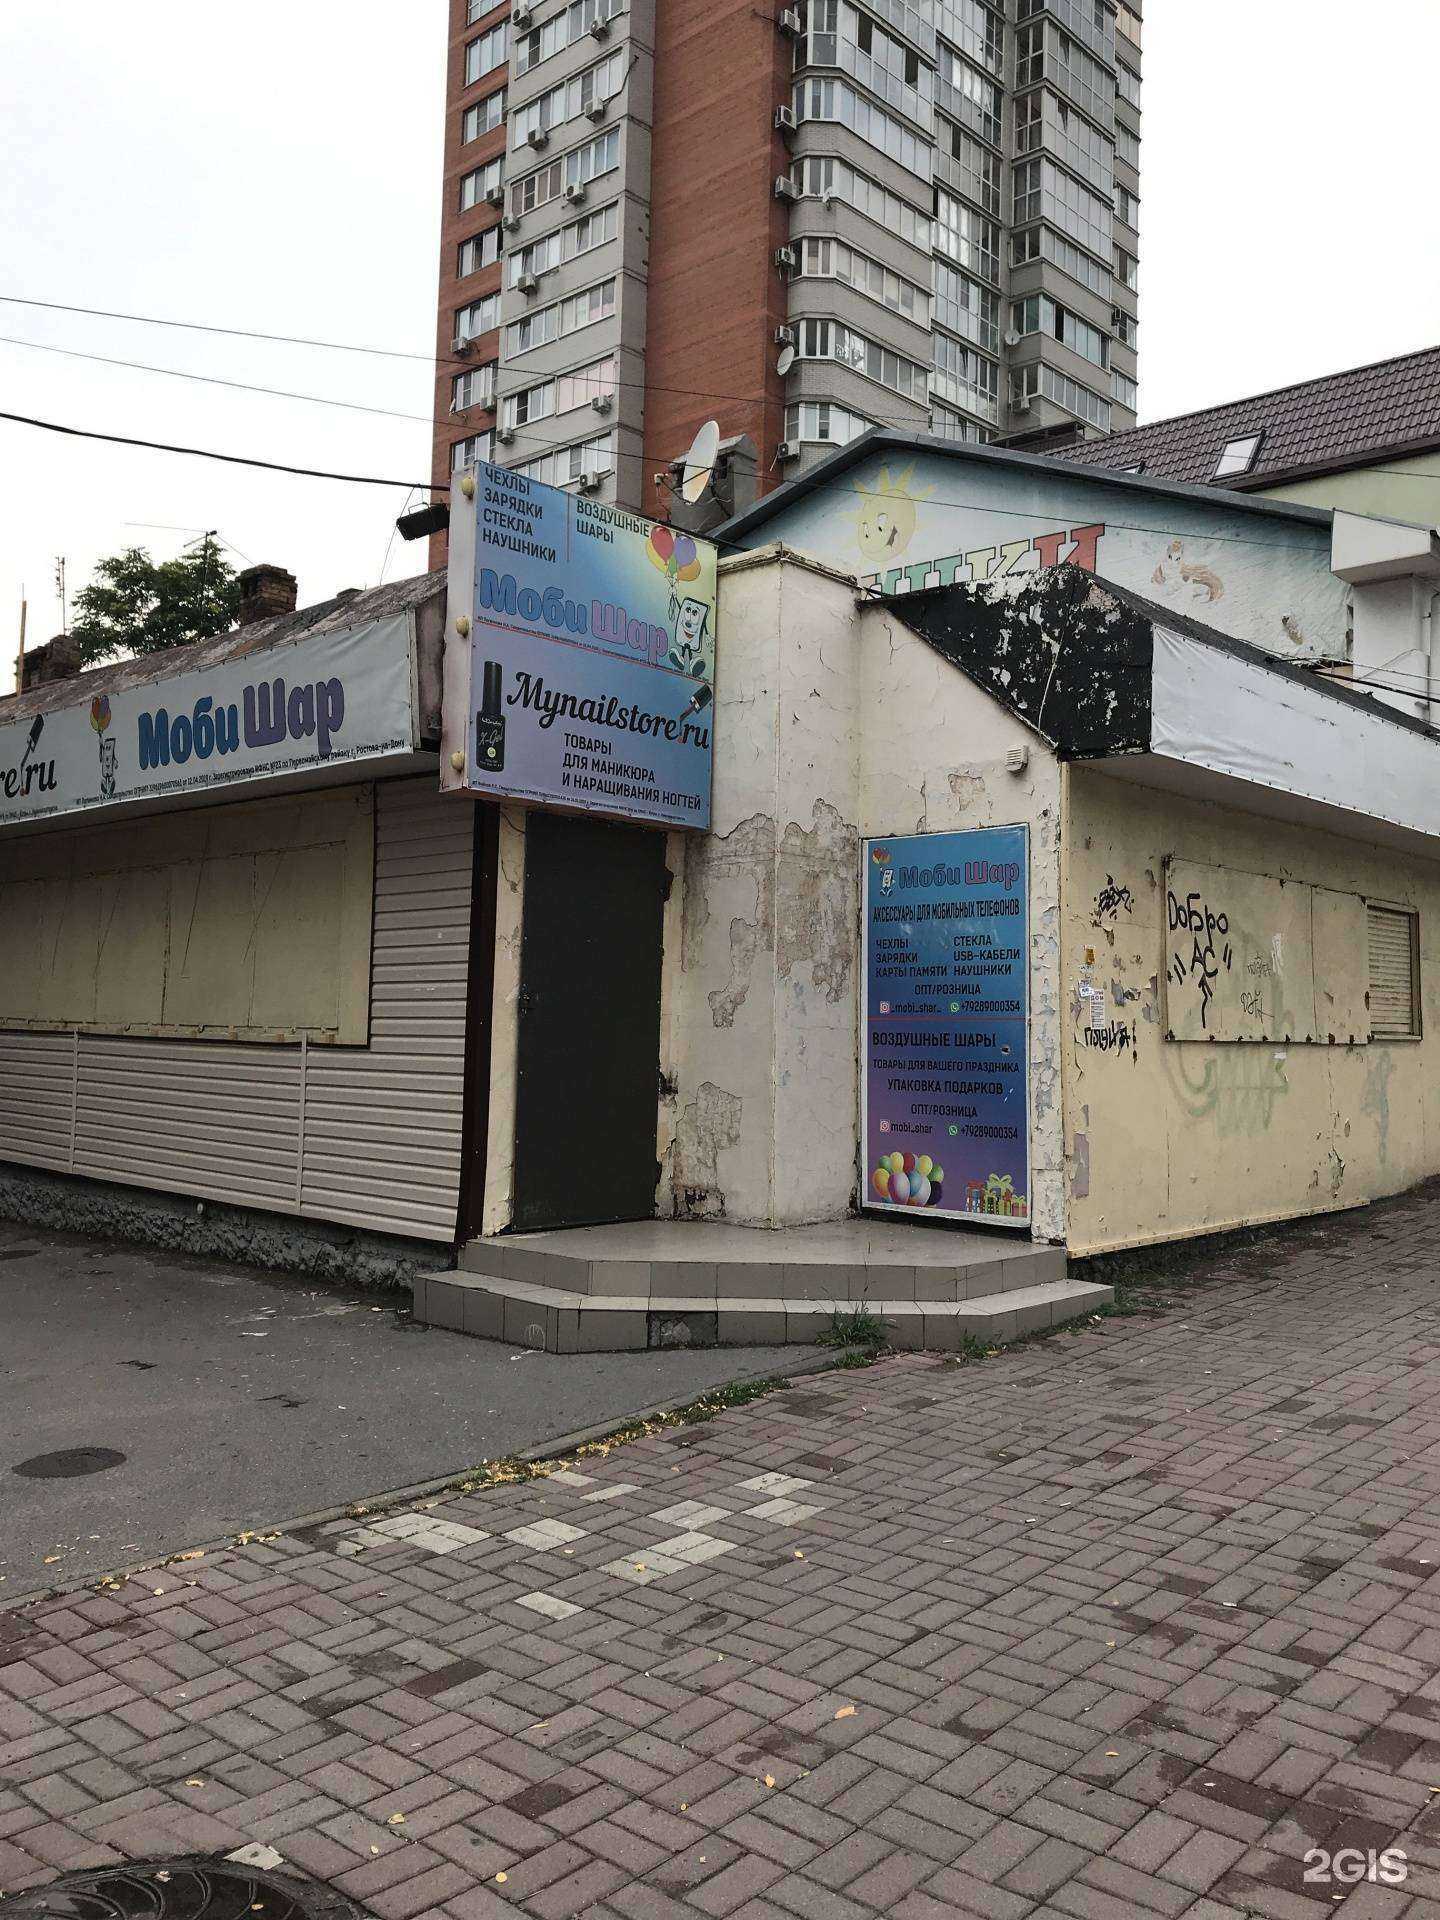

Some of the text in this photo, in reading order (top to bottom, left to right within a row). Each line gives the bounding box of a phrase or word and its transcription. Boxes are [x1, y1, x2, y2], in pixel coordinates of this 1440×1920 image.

[485, 467, 531, 496] ЧЕХЛЫ
[484, 487, 543, 520] ЗАРЯДКИ
[483, 508, 534, 537] СТЕКЛА
[576, 499, 650, 538] ВОЗДУШНЫЕ
[576, 518, 614, 544] ШАРЫ
[482, 528, 557, 563] НАУШНИКИ
[506, 671, 710, 750] Mynailstore.ru
[564, 732, 612, 756] ТОВАРЫ
[562, 752, 656, 784] ДЛЯ МАНИКЮРА
[562, 772, 570, 787] И
[573, 774, 660, 803] НАРАЩИВАНИЯ
[662, 791, 702, 812] НОГТЕЙ
[873, 898, 1020, 922] АКСЕССУАРЫ ДЛЯ МОБИЛЬНЫХ ТЕЛЕФОНОВ
[875, 938, 909, 950] ЧЕХЛЫ
[953, 934, 993, 947] СТЕКЛА
[875, 952, 918, 964] ЗАРЯДКИ
[953, 949, 1020, 962] USB-КАБЕЛИ
[875, 966, 948, 978] КАРТЫ ПАМЯТИ
[953, 963, 1012, 977] НАУШНИКИ
[914, 982, 982, 996] ОПТ/РОЗНИЦА
[872, 1032, 996, 1048] ВОЗДУШНЫЕ ШАРЫ
[873, 1059, 1020, 1074] ТОВАРЫ ДЛЯ ВАШЕГО ПРАЗДНИКА
[887, 1078, 1004, 1095] УПАКОВКА ПОДАРКОВ
[911, 1103, 978, 1118] ОПТ/РОЗНИЦА
